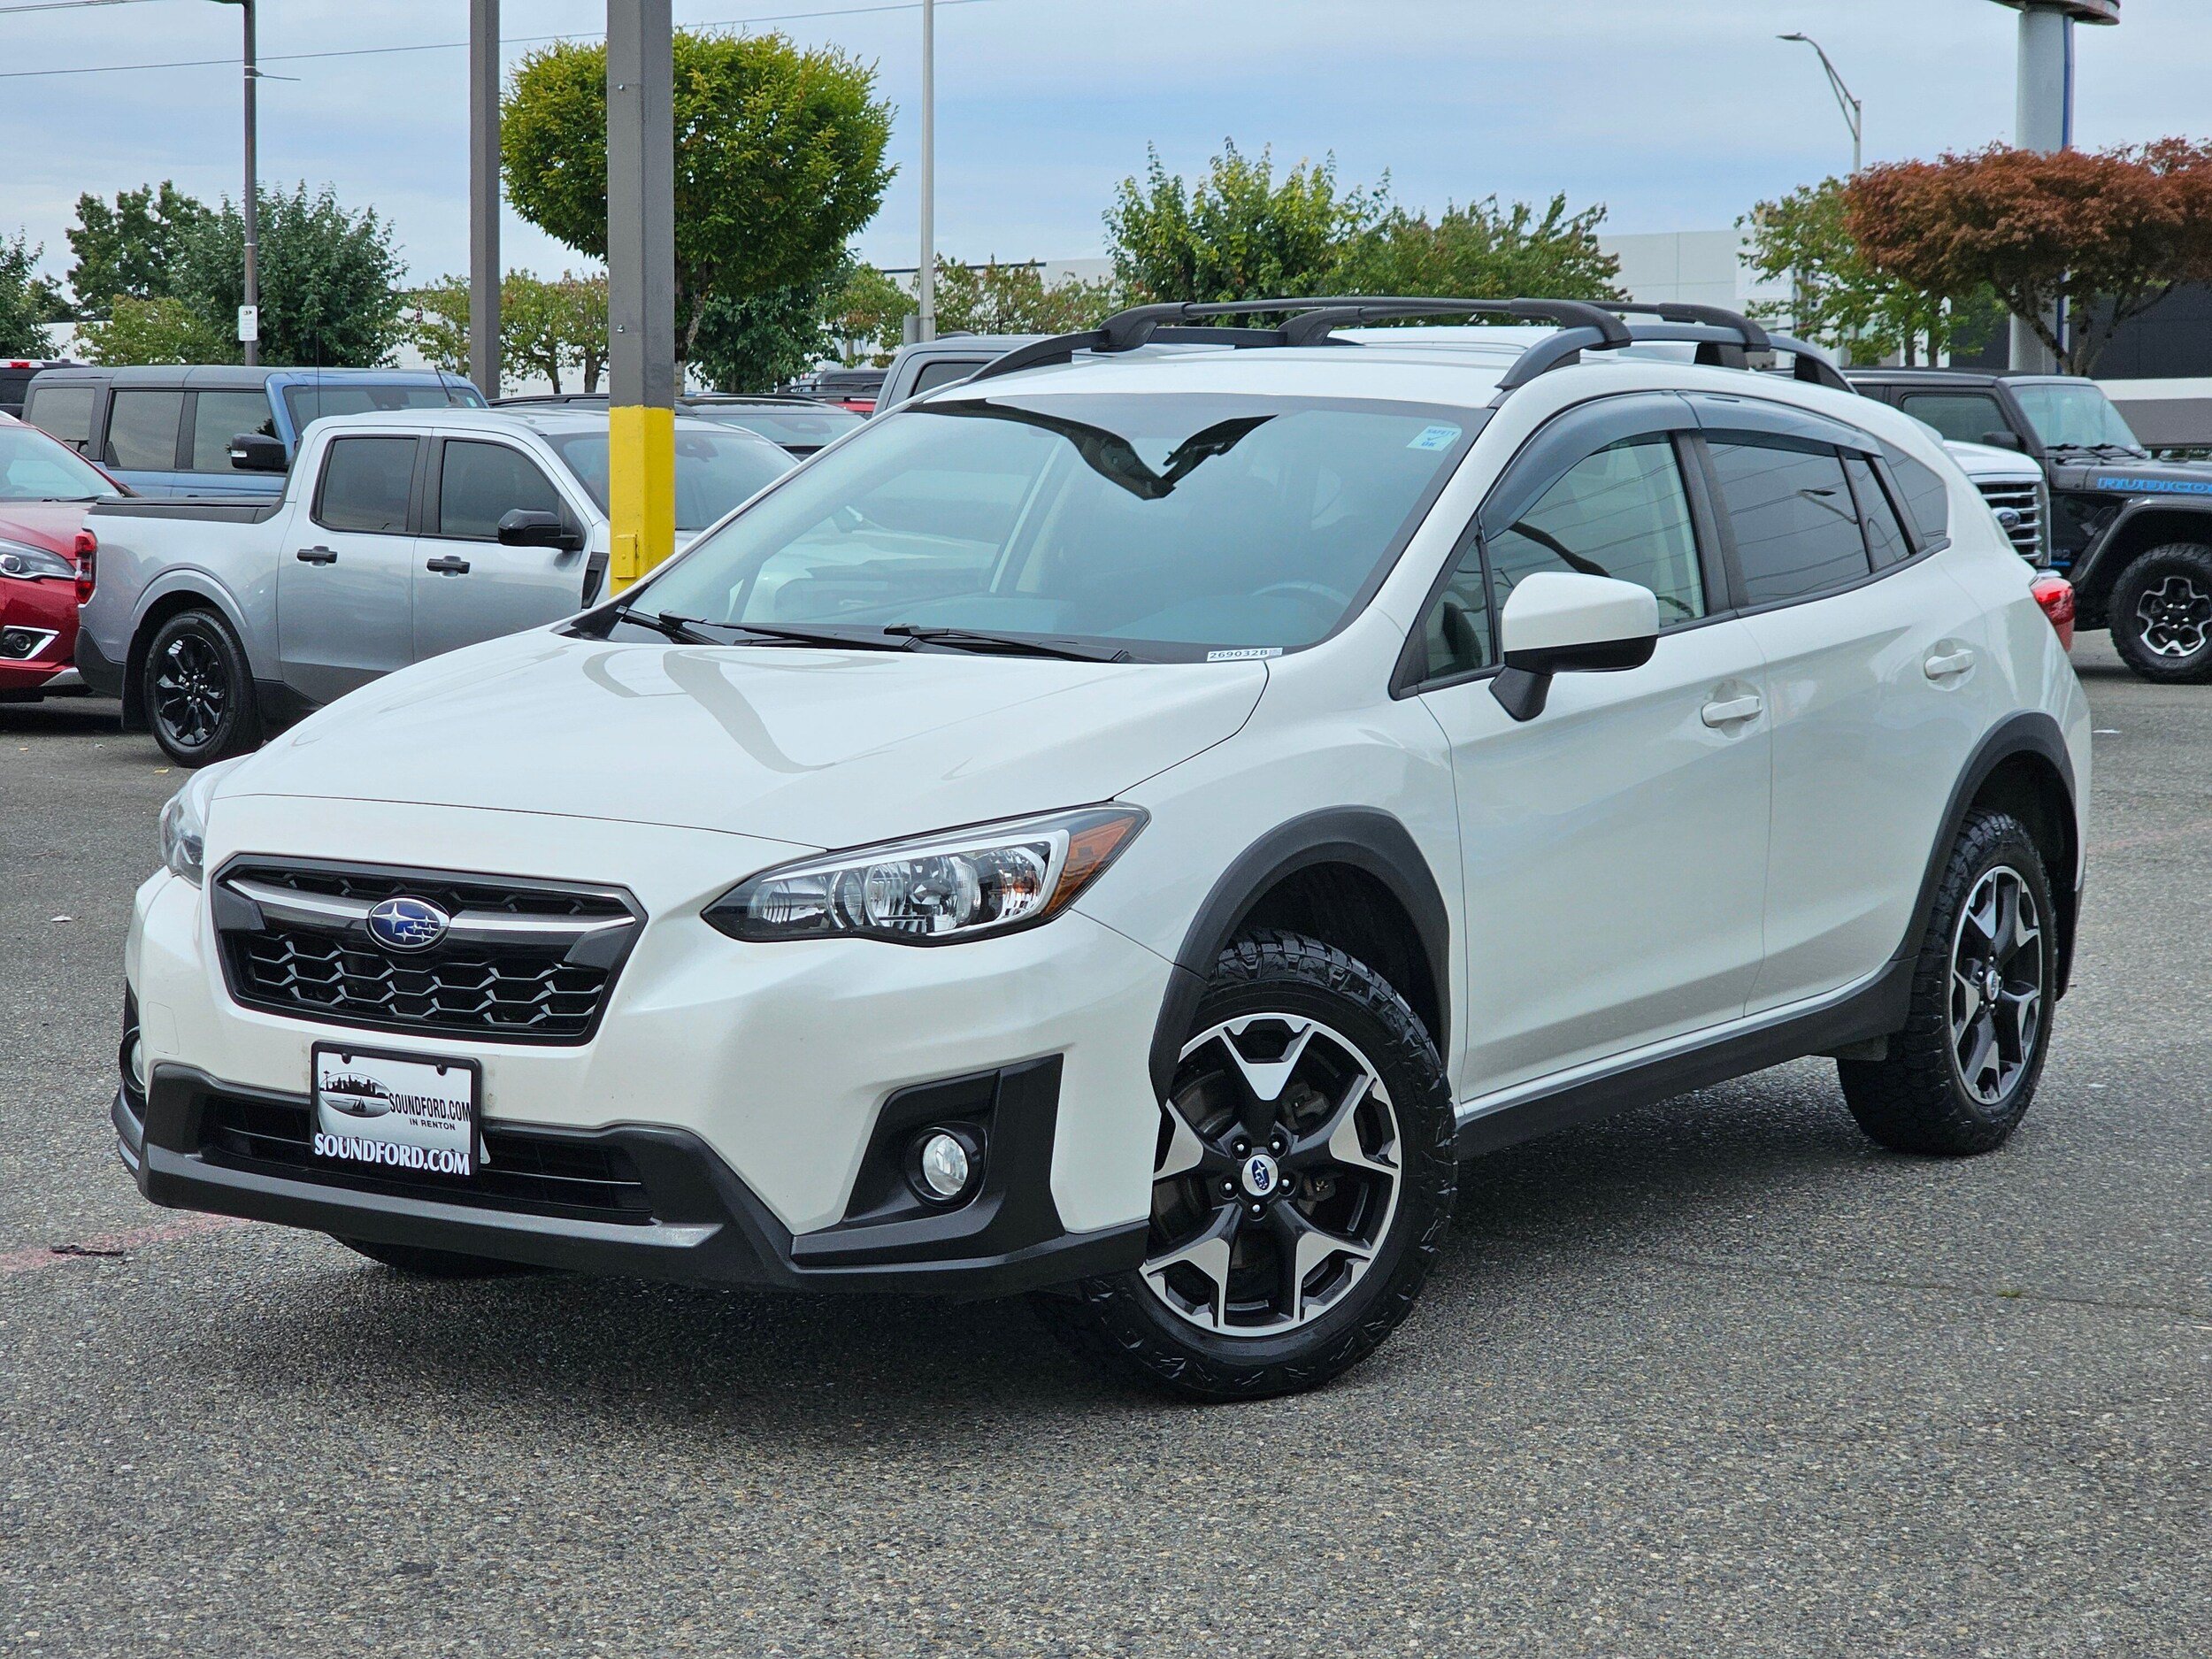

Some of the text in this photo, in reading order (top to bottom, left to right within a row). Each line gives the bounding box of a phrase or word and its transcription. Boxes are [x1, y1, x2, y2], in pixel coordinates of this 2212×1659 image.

[2097, 477, 2212, 494] RUBICO
[388, 1093, 471, 1122] SOUNDFORD.COM
[410, 1118, 456, 1131] IN RENTON
[314, 1133, 471, 1176] SOUNDFORD.COM
